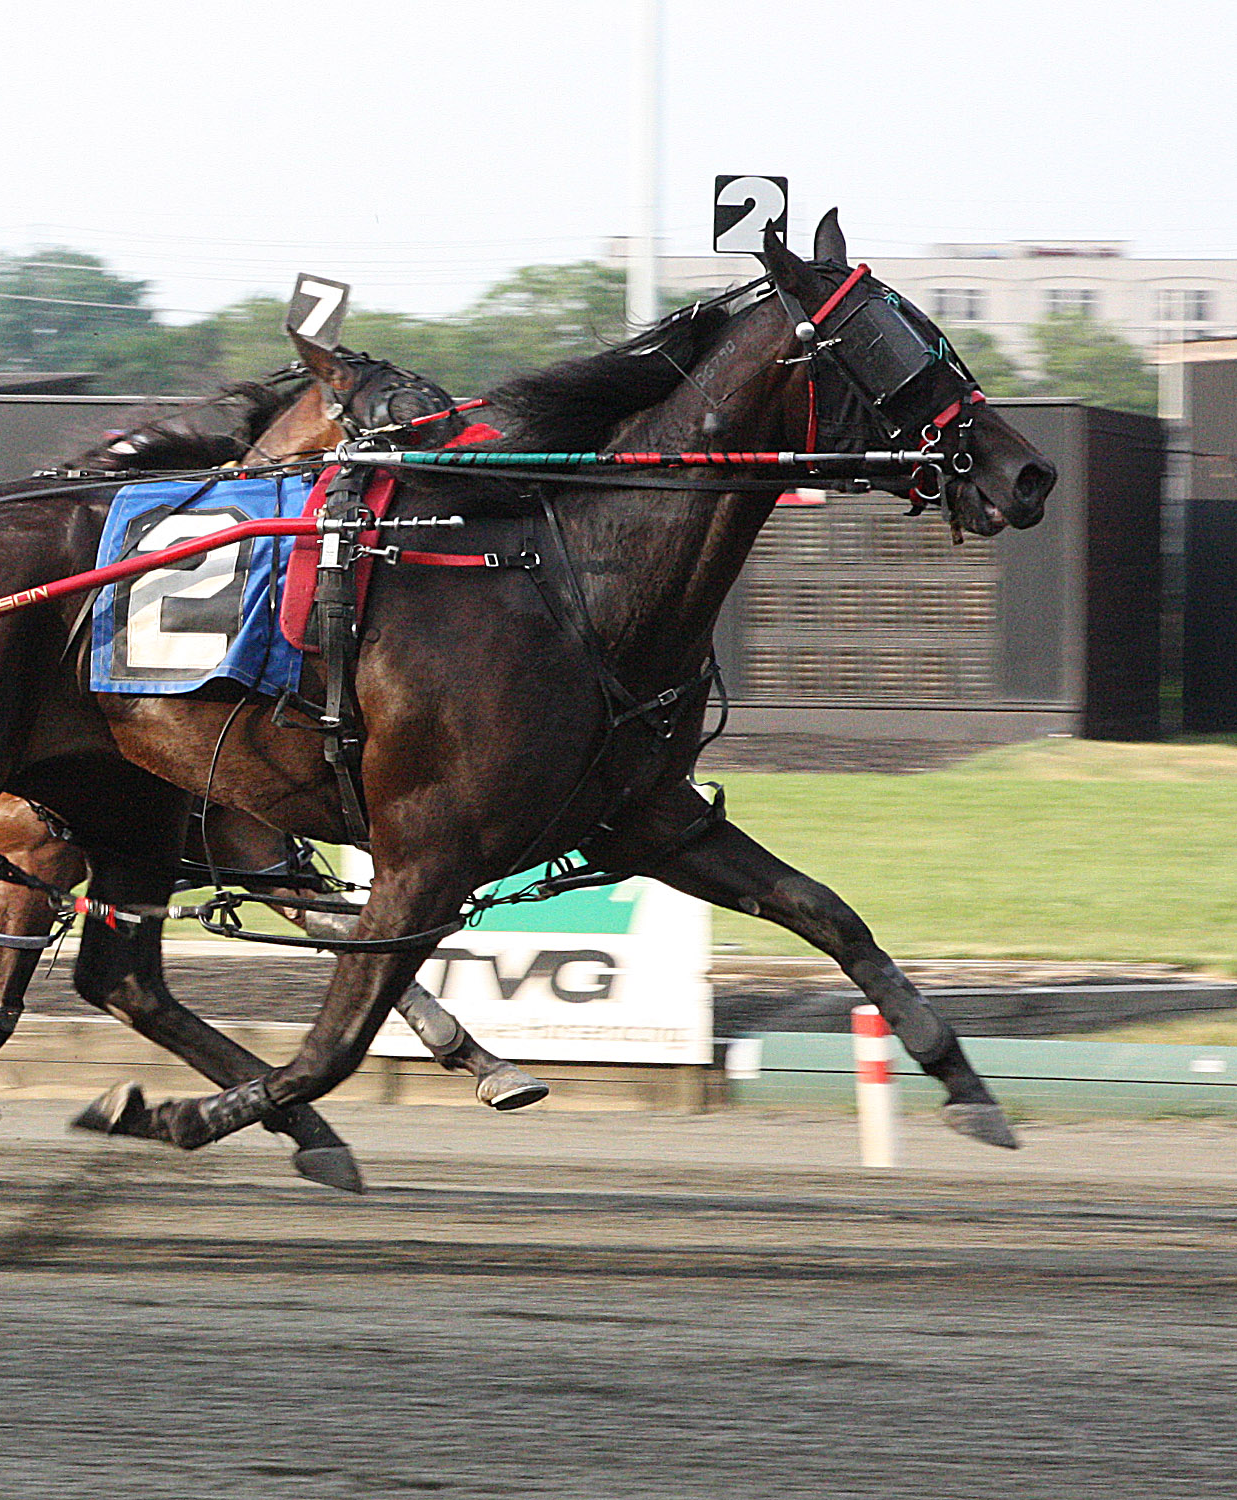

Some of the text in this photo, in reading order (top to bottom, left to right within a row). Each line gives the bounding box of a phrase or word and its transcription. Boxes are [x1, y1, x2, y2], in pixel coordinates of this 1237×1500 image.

[716, 175, 786, 254] 2
[295, 280, 345, 337] 7
[126, 512, 242, 670] 2
